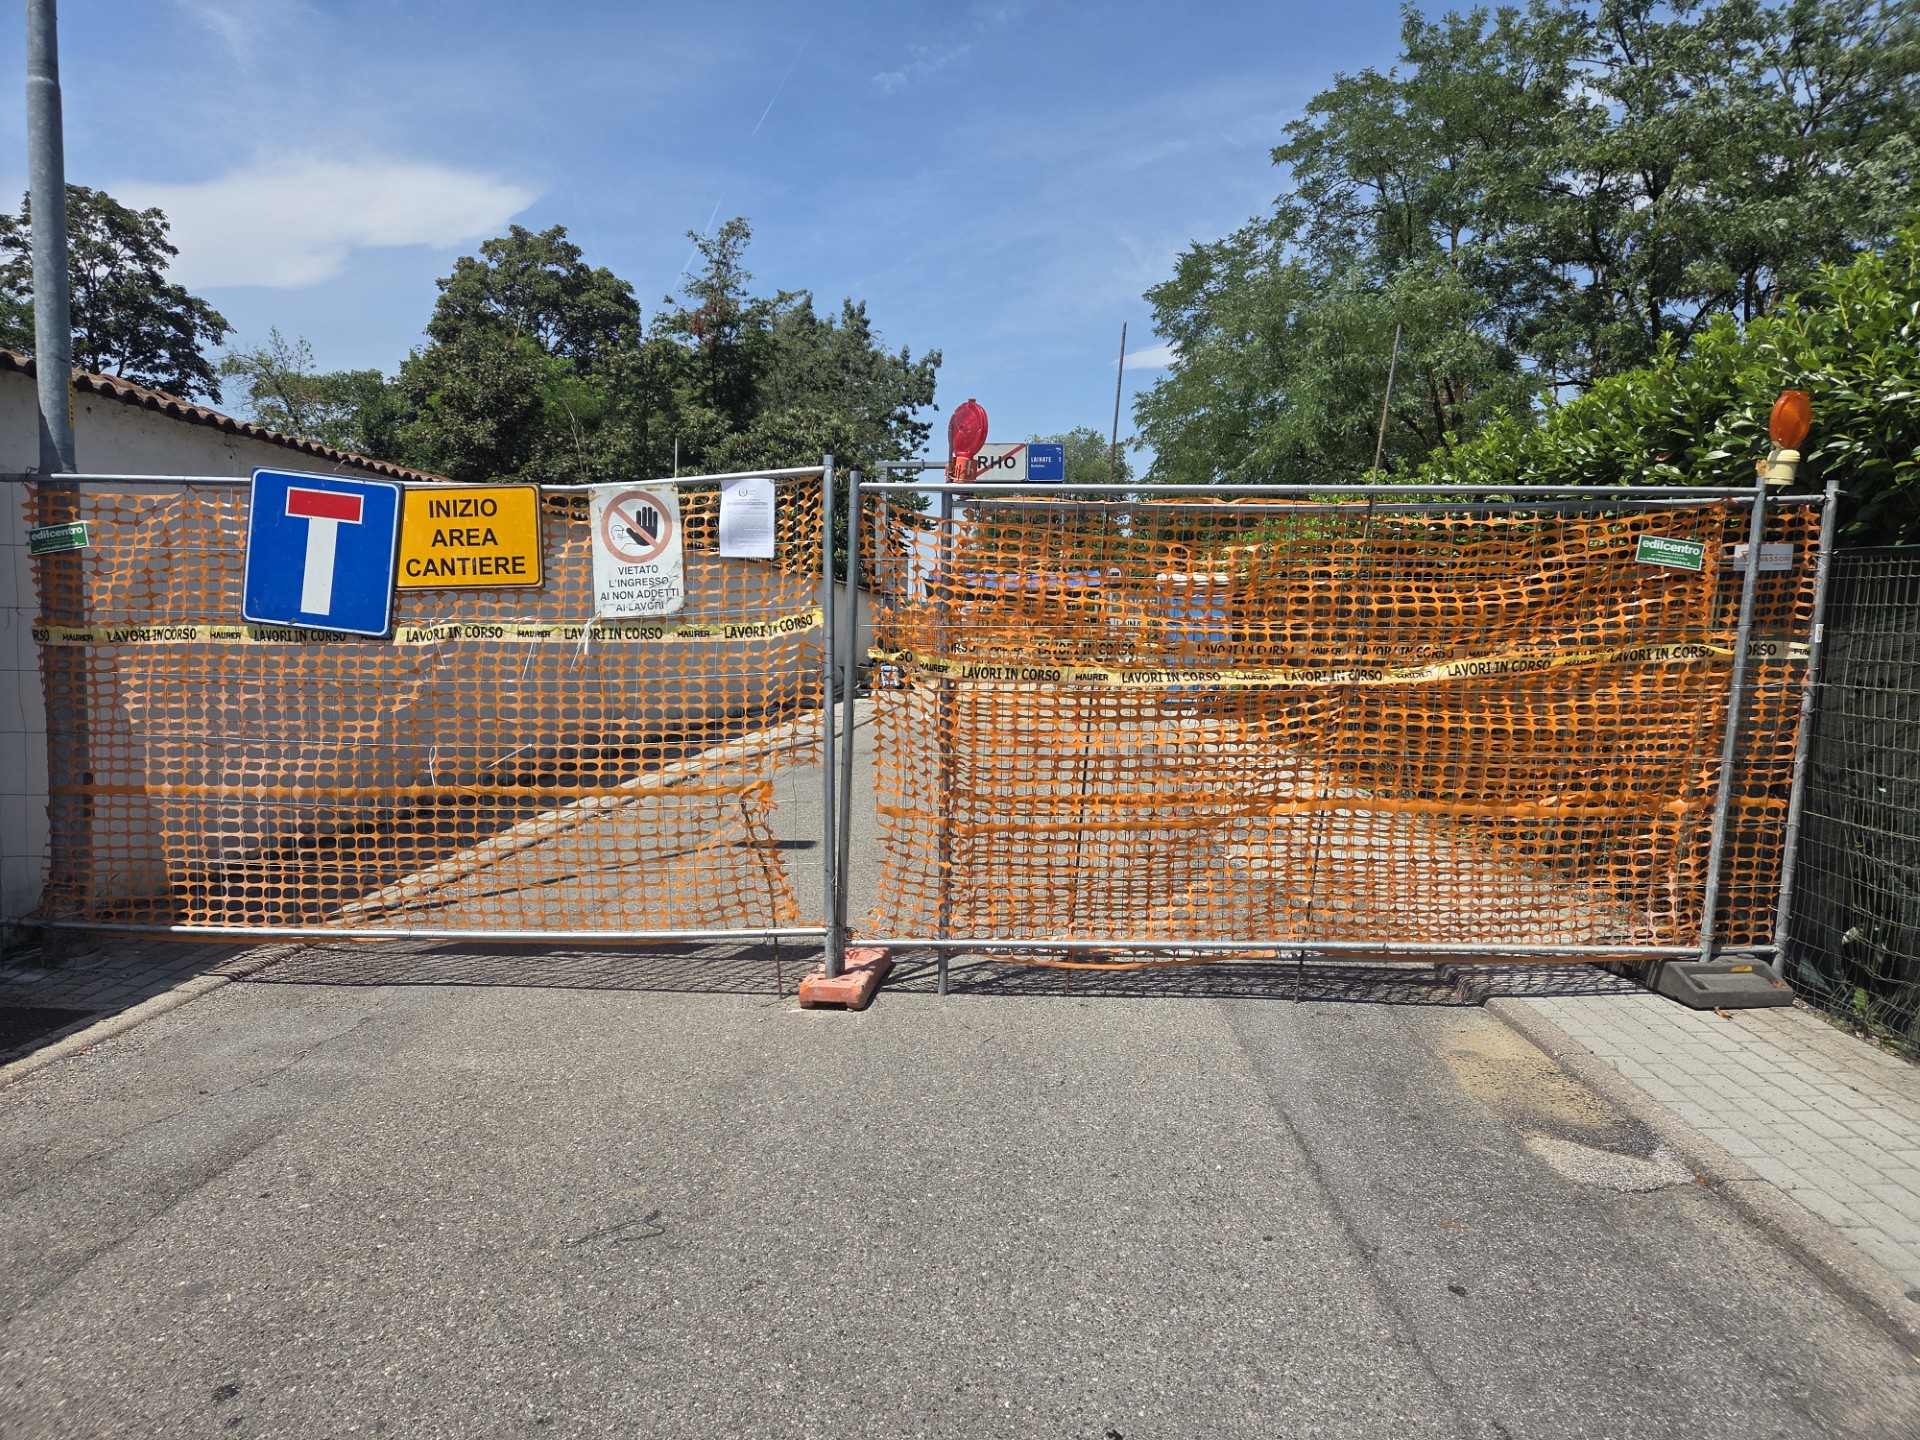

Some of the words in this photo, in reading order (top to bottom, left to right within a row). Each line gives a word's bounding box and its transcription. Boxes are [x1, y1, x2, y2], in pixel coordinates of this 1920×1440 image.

[977, 455, 1016, 469] RHO
[429, 498, 498, 518] INIZIO
[31, 527, 83, 540] edilcentro
[431, 528, 498, 547] AREA
[1642, 540, 1700, 555] edilcentro
[405, 556, 526, 577] CANTIERE
[618, 565, 659, 575] VIETATO
[608, 577, 669, 588] L'INGRESSO
[600, 592, 610, 600] AI
[612, 591, 634, 600] NON
[636, 588, 680, 599] ADDETTI
[616, 604, 626, 612] AI
[62, 633, 94, 641] MAURER
[107, 630, 151, 642] LAVORI
[152, 629, 164, 641] IN
[164, 628, 197, 640] CORSO
[210, 632, 242, 640] MAURER
[254, 629, 292, 642] LAVORI
[294, 629, 307, 642] IN
[406, 627, 445, 642] LAVORI
[448, 626, 462, 639] IN
[465, 626, 503, 638] CORSO
[608, 628, 622, 640] IN
[625, 628, 663, 640] CORSO
[677, 629, 710, 638] MAURER
[724, 626, 765, 639] LAVORI
[779, 614, 813, 632] CORSO
[962, 665, 1002, 679] LAVORI
[1005, 667, 1018, 680] IN
[1022, 668, 1061, 681] CORSO
[1075, 673, 1109, 681] MAURER
[1122, 672, 1163, 684] LAVORI
[1165, 671, 1180, 682] IN
[1183, 672, 1221, 681] CORSO
[1283, 671, 1327, 682] LAVORI
[1347, 669, 1383, 681] CORSO
[1446, 662, 1491, 676] LAVORI
[1493, 661, 1508, 673] IN
[1511, 660, 1551, 672] CORSO
[1610, 648, 1651, 663] LAVORI
[1655, 647, 1669, 659] IN
[1673, 645, 1715, 659] CORSO
